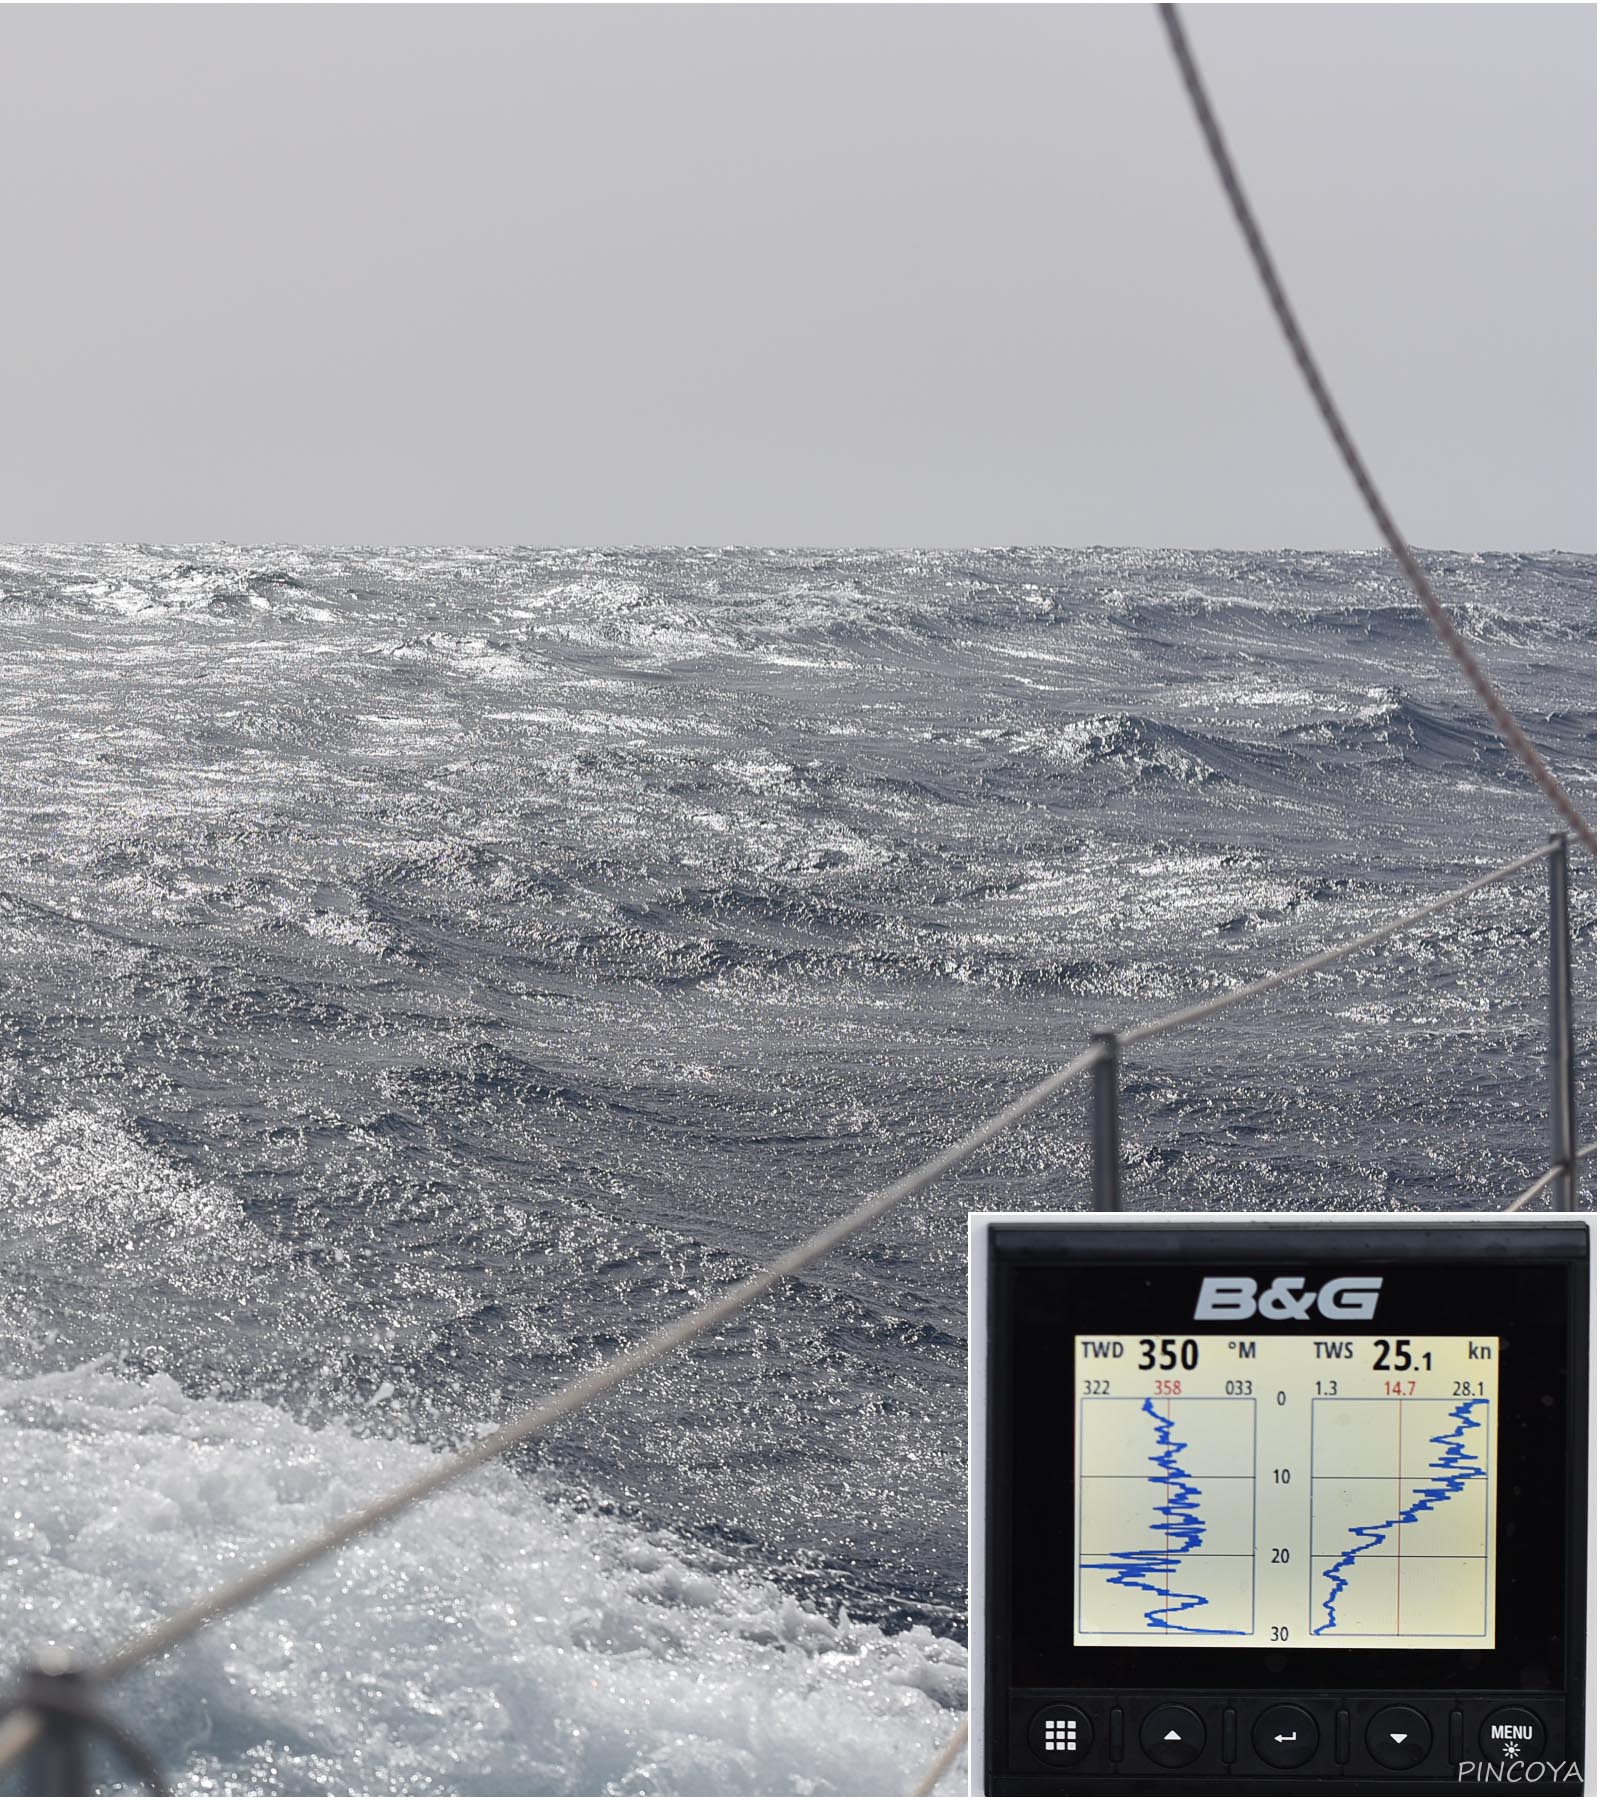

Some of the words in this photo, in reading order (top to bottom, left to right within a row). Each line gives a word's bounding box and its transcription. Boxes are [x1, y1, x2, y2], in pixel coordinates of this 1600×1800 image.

[1193, 1276, 1384, 1321] B&G
[1082, 1341, 1124, 1360] TWD
[1138, 1338, 1199, 1371] 350
[1228, 1341, 1257, 1359] °M
[1314, 1341, 1354, 1360] TWS
[1372, 1338, 1433, 1372] 25.1
[1468, 1341, 1492, 1361] kn
[1083, 1380, 1110, 1396] 322
[1154, 1380, 1182, 1396] 358
[1225, 1380, 1253, 1396] 033
[1315, 1380, 1338, 1396] 1.3
[1384, 1380, 1416, 1396] 14.7
[1452, 1380, 1485, 1396] 28.1
[1276, 1390, 1286, 1407] 0
[1273, 1469, 1291, 1485] 10
[1271, 1548, 1290, 1564] 20
[1270, 1626, 1289, 1642] 30
[1491, 1724, 1533, 1740] MENU
